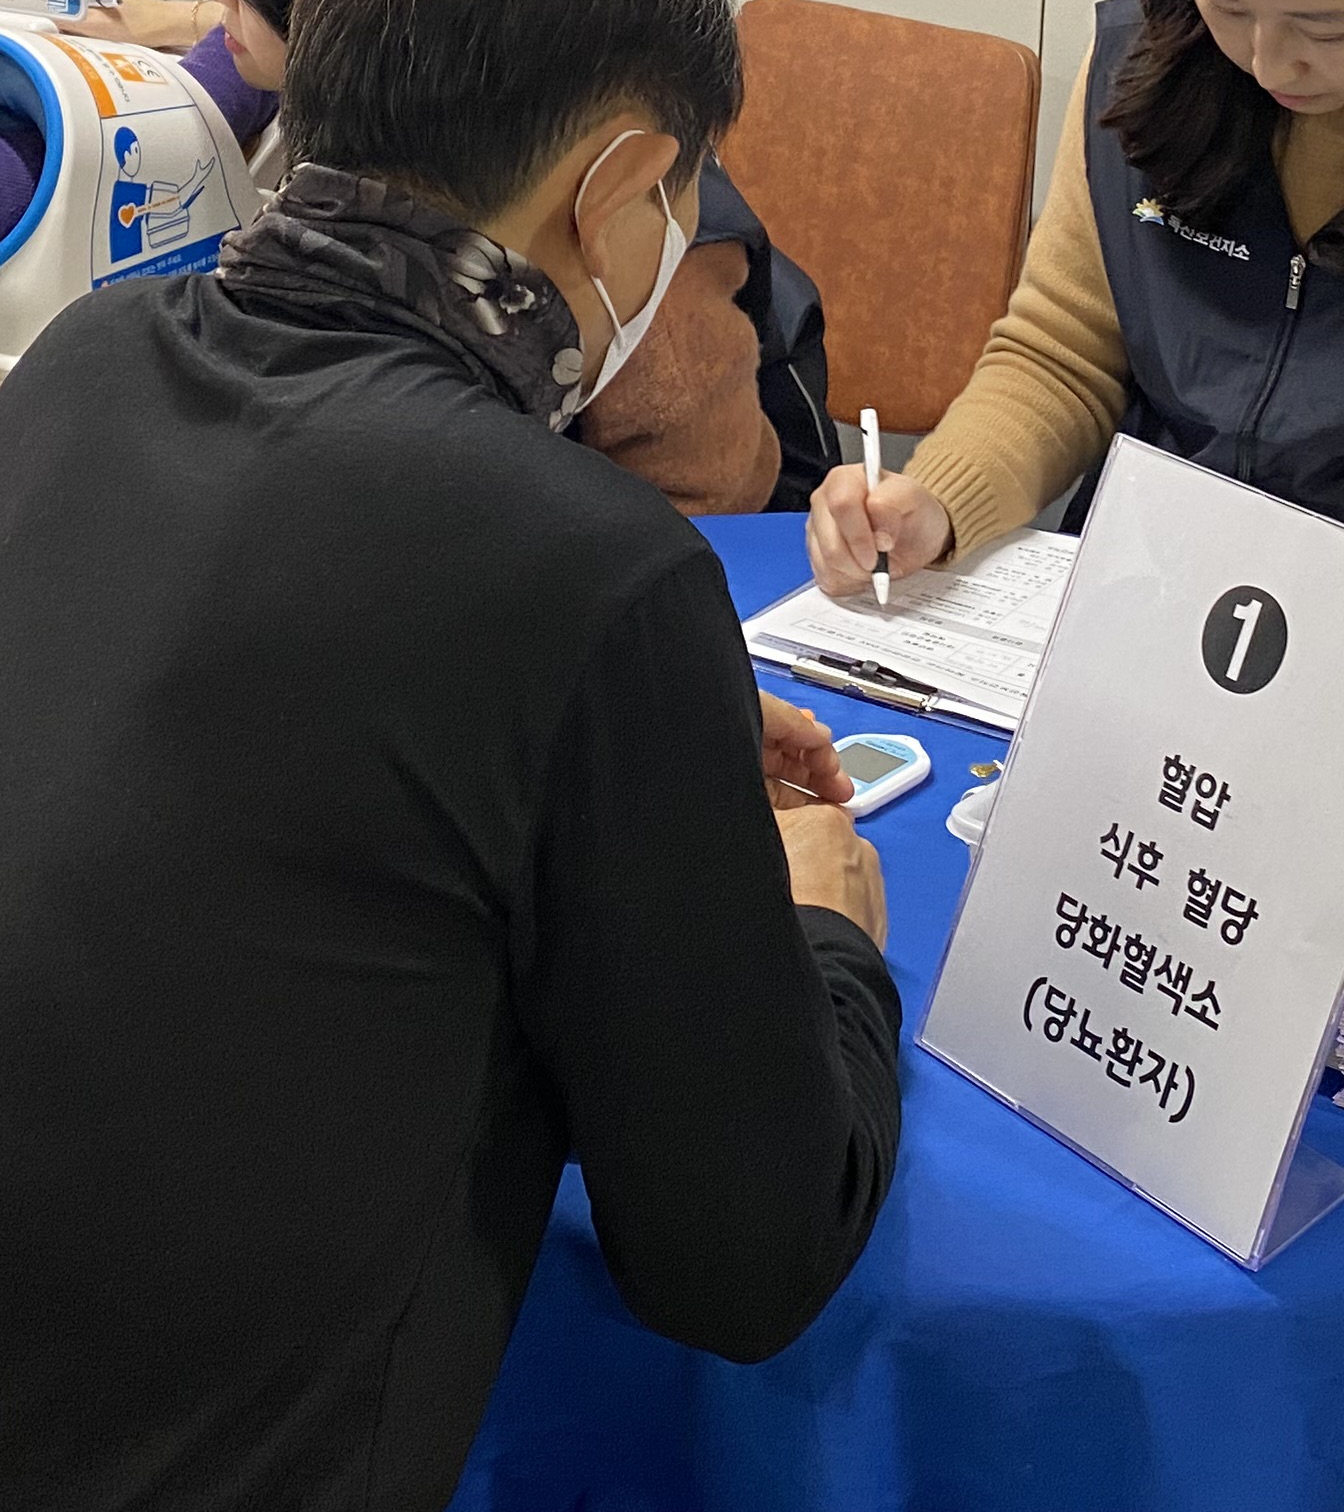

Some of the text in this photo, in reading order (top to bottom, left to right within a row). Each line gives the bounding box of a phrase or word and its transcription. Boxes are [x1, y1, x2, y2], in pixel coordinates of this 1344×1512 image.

[1167, 214, 1250, 261] 독산보건지소
[1158, 753, 1232, 831] 혈압
[1100, 822, 1260, 946] 식후 혈당
[1055, 891, 1223, 1031] 당화혈색소
[1023, 976, 1196, 1124] (당뇨환자)
